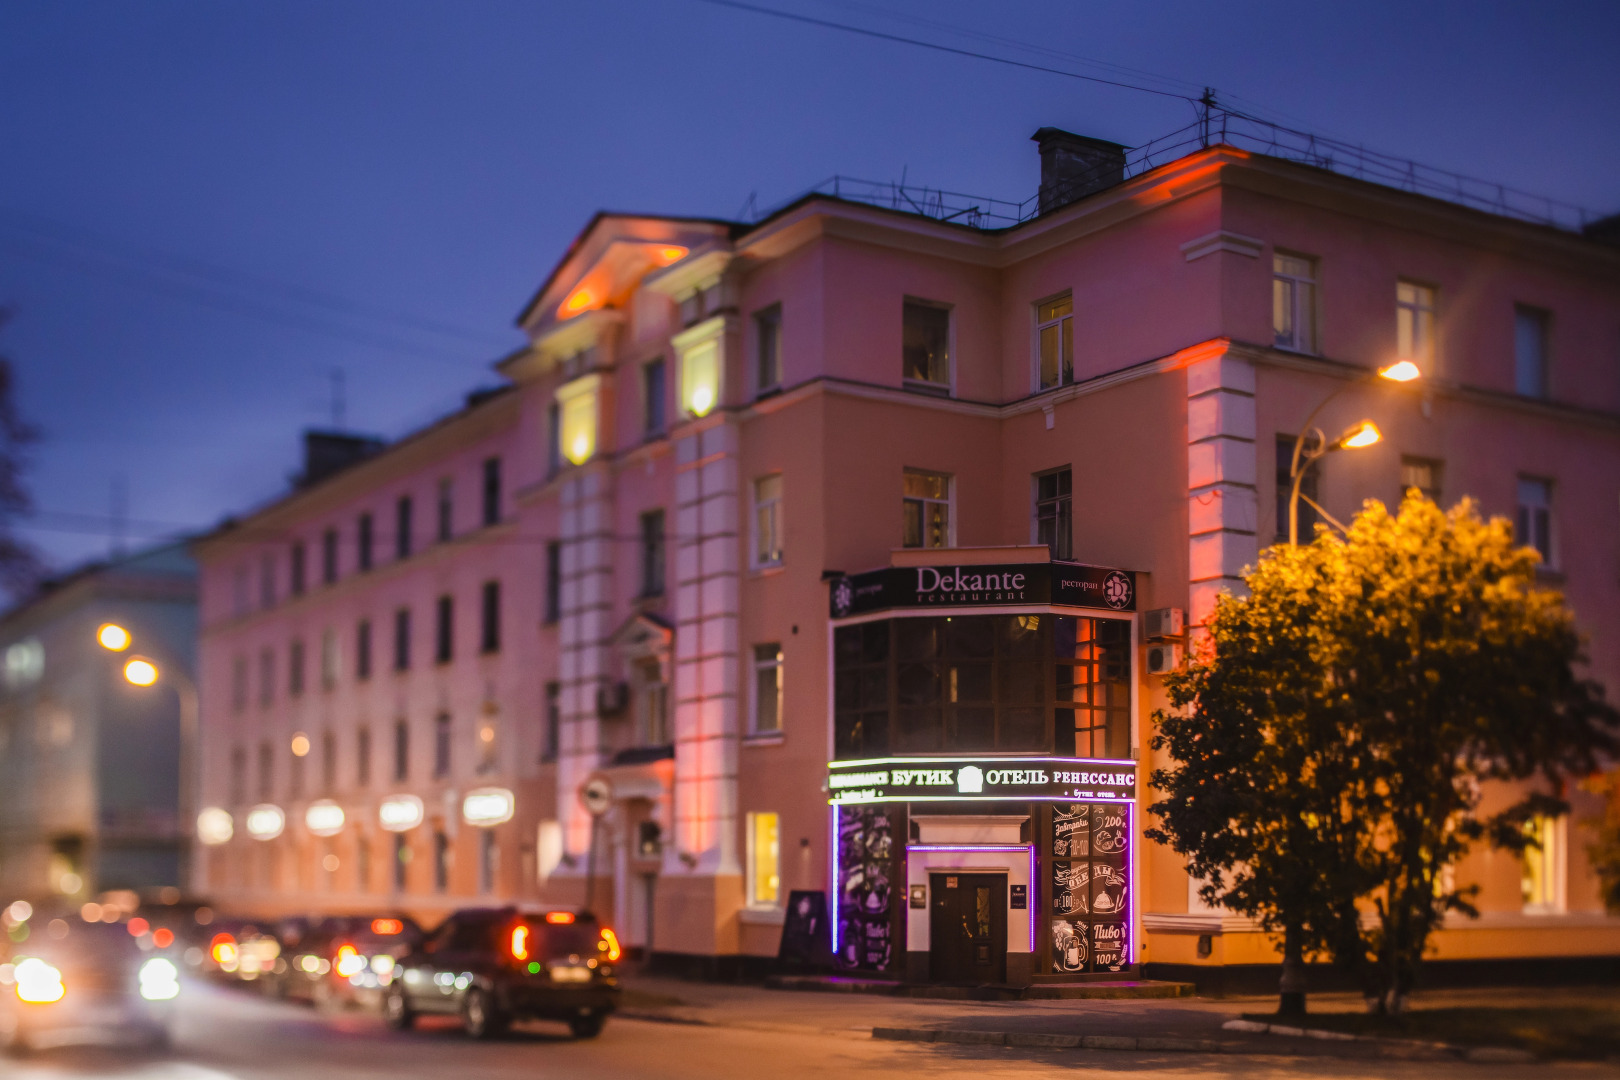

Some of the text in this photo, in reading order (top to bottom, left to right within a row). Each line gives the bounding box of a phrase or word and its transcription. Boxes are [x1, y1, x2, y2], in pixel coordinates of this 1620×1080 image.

[916, 567, 1025, 593] Dekante
[1061, 579, 1098, 591] ресторан
[917, 591, 1025, 603] restaurant
[890, 769, 955, 786] БУТИК
[985, 769, 1049, 785] ОТЕЛЬ
[1053, 771, 1135, 786] РЕНЕССАНС
[1073, 788, 1116, 799] бутик отель
[1055, 818, 1089, 836] Завтраки
[1104, 815, 1122, 828] 200
[1093, 924, 1120, 939] Пиво
[1096, 953, 1111, 965] 100
